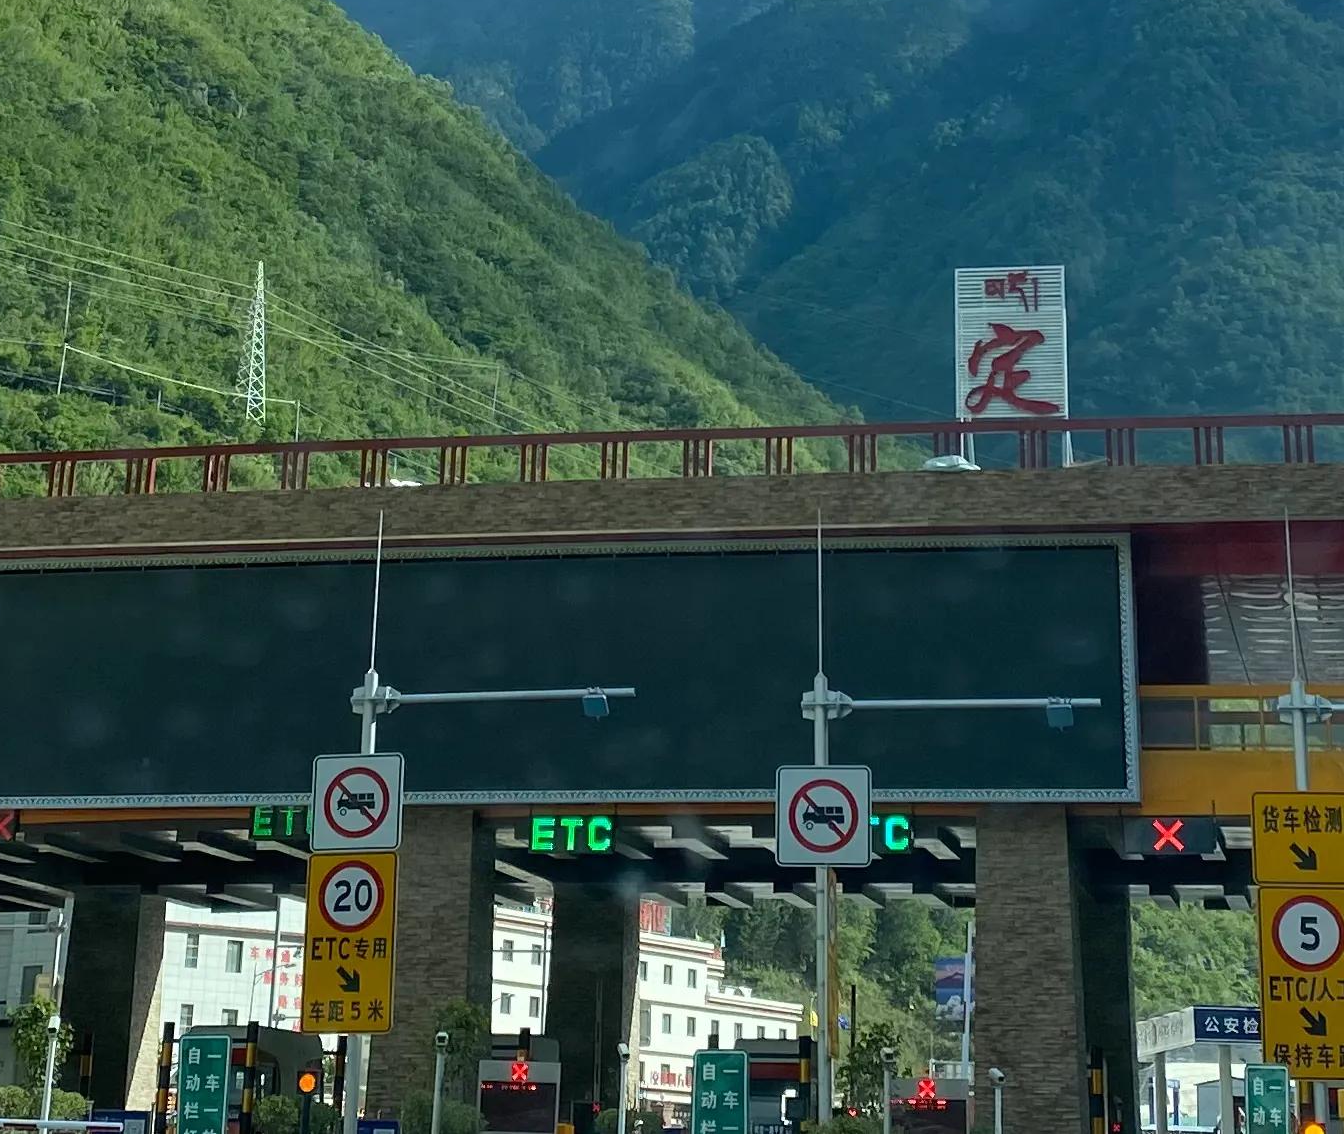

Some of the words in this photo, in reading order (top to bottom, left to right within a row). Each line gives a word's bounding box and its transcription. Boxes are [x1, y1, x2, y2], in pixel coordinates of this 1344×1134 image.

[964, 322, 1060, 414] 定
[253, 807, 311, 836] ET
[531, 818, 612, 852] ETC
[1262, 805, 1343, 834] 货车检测
[333, 879, 372, 912] 20
[1300, 916, 1320, 951] 5
[1252, 1077, 1266, 1126] 自动
